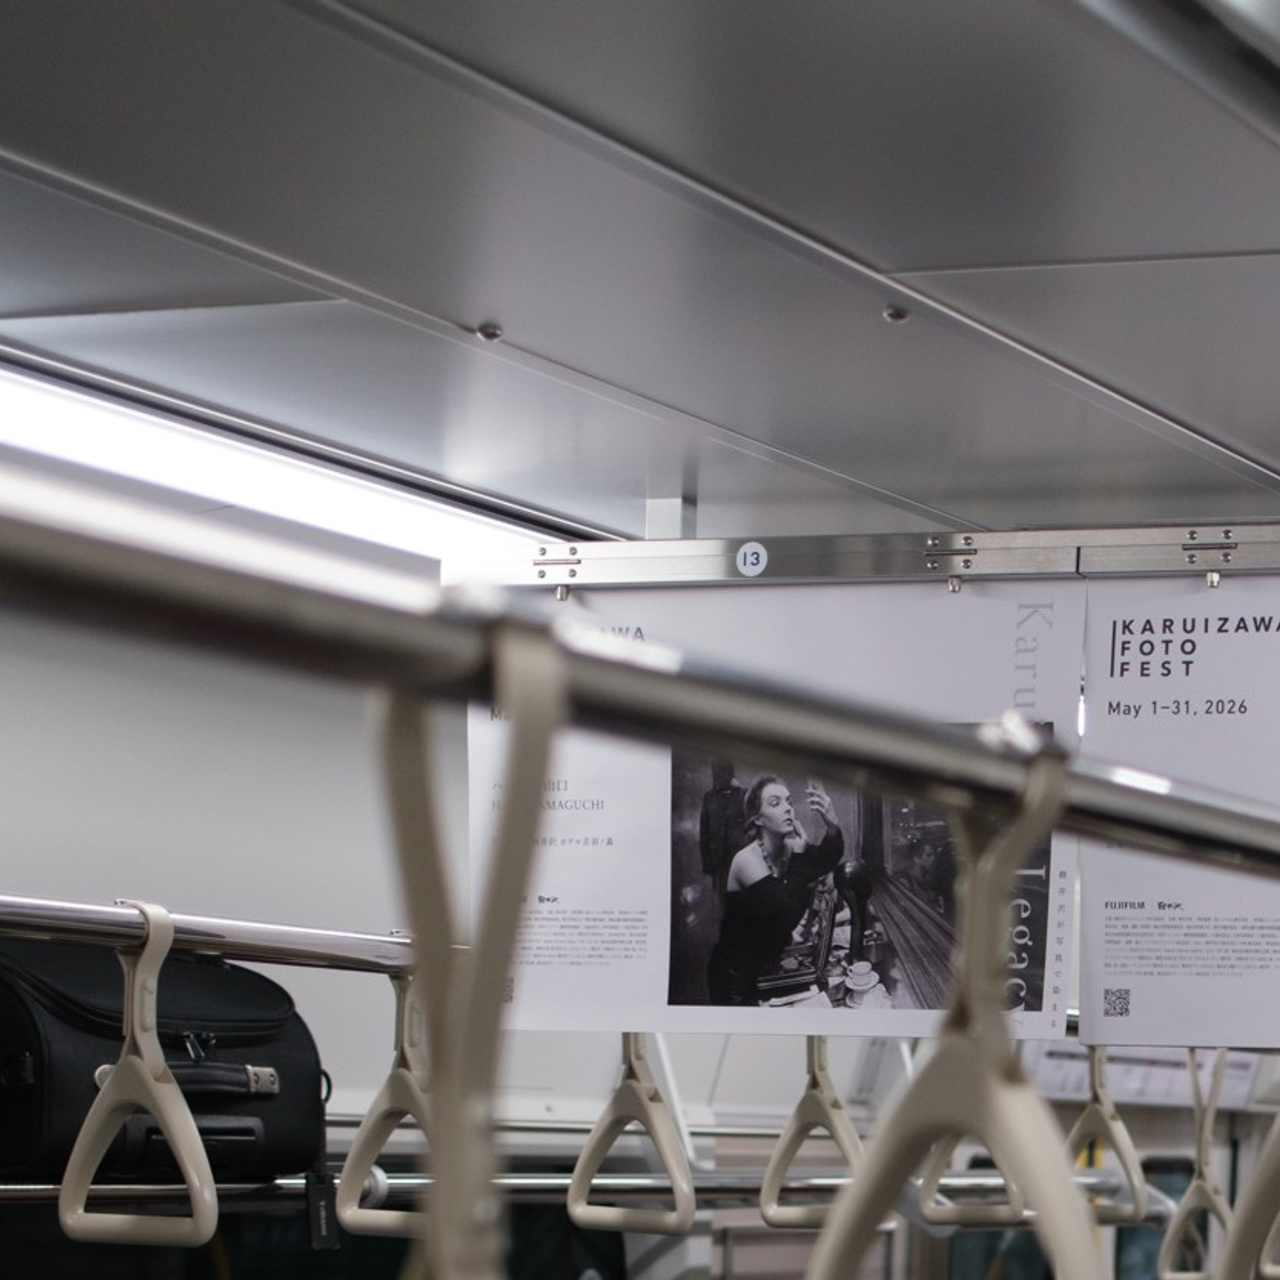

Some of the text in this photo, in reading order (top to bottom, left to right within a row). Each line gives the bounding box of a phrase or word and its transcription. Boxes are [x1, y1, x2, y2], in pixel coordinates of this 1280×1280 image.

[743, 551, 760, 567] 13
[1120, 639, 1197, 656] FOTO
[1119, 660, 1194, 677] FEST
[1107, 701, 1142, 719] May
[1204, 699, 1248, 715] 2026
[1104, 901, 1146, 910] FUJIFILM
